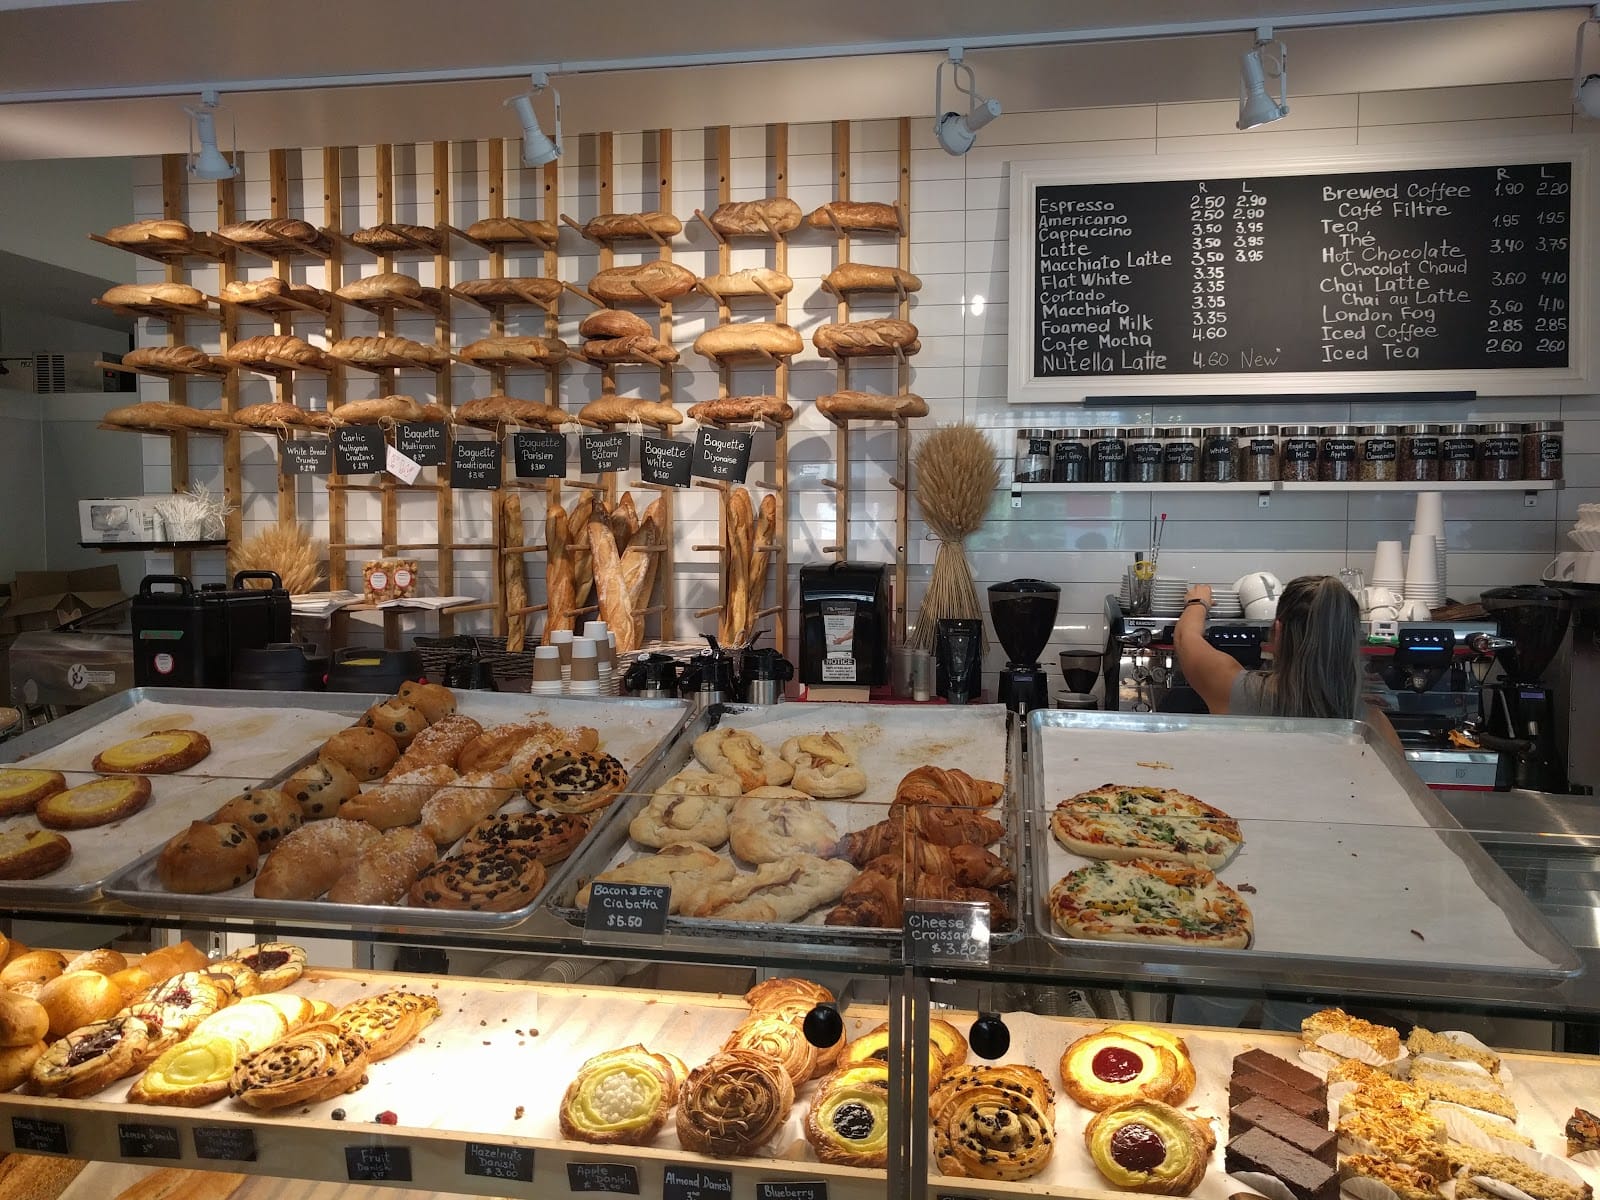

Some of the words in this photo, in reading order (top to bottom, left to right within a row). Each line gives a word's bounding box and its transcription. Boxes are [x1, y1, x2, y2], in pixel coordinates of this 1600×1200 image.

[1497, 167, 1511, 180] R
[1541, 166, 1555, 178] L
[1199, 182, 1208, 193] R
[1242, 181, 1252, 193] L
[1323, 184, 1398, 201] Brewed
[1407, 182, 1471, 202] Coffee
[1536, 182, 1569, 196] 2.20
[1039, 198, 1115, 214] Espresso
[1190, 195, 1225, 210] 2.50
[1236, 194, 1267, 207] 2.90
[1338, 201, 1383, 220] Café
[1393, 200, 1452, 218] Filtre
[1039, 214, 1127, 228] Americano
[1191, 209, 1225, 222] 2.50
[1233, 208, 1265, 219] 2.90
[1320, 219, 1359, 234] Tea
[1491, 214, 1520, 228] 1.95
[1537, 211, 1566, 225] 1.95
[1039, 227, 1132, 242] Cappuccino
[1191, 223, 1222, 236] 3.50
[1235, 222, 1264, 234] 3.95
[1339, 231, 1376, 247] Thé
[1040, 242, 1092, 257] Latte
[1191, 237, 1222, 250] 3.50
[1233, 236, 1265, 248] 3.95
[1322, 246, 1354, 263] Hot
[1362, 239, 1466, 262] Chocolate
[1489, 239, 1525, 253] 3.40
[1535, 236, 1569, 251] 3.75
[1040, 255, 1121, 273] Macchiato
[1127, 251, 1173, 268] Latte
[1191, 252, 1225, 266] 3.50
[1235, 249, 1264, 262] 3.95
[1340, 260, 1411, 277] Chocolat
[1418, 259, 1468, 275] Chaud
[1041, 274, 1077, 290] Flat
[1081, 271, 1132, 286] White
[1193, 267, 1225, 280] 3.35
[1319, 276, 1363, 293] Chai
[1375, 276, 1431, 292] Latte
[1491, 271, 1527, 287] 3.60
[1040, 289, 1105, 304] Cortado
[1192, 280, 1225, 294] 3.35
[1043, 300, 1130, 319] Macchiato
[1191, 295, 1226, 309] 3.35
[1341, 292, 1379, 306] Chai
[1389, 293, 1409, 305] au
[1415, 289, 1472, 304] Latte
[1488, 299, 1524, 316] 3.60
[1323, 304, 1393, 324] London
[1401, 306, 1436, 323] Fog
[1042, 319, 1111, 337] Foamed
[1119, 314, 1154, 331] Milk
[1193, 311, 1228, 326] 3.35
[1321, 325, 1366, 341] Iced
[1375, 323, 1440, 343] Coffee
[1488, 318, 1524, 333] 2.85
[1535, 318, 1568, 332] 2.85
[1041, 336, 1089, 357] Cafe
[1099, 333, 1152, 349] Mocha
[1192, 328, 1228, 342] 4.60
[1322, 344, 1368, 363] Iced
[1382, 343, 1420, 361] Tea
[1485, 338, 1523, 353] 2.60
[1043, 351, 1114, 373] Nutella
[1122, 349, 1168, 370] Latte
[1193, 351, 1229, 367] 4.60
[341, 431, 366, 443] Garlic
[404, 426, 440, 443] Baguette
[519, 434, 560, 452] Baguette
[704, 433, 745, 452] Baguette
[287, 447, 307, 456] White
[309, 444, 327, 456] Bread
[401, 441, 436, 456] Multigrain
[585, 436, 623, 452] Baguette
[645, 440, 687, 459] Baguette
[458, 446, 495, 461] Baguette
[522, 450, 553, 461] Parisien
[704, 450, 738, 465] Dijonaise
[1330, 450, 1346, 459] Apple
[455, 460, 496, 471] Traditional
[646, 457, 673, 469] White
[826, 658, 854, 666] NOTICE
[594, 884, 628, 896] Bacon
[640, 886, 664, 898] Brie
[603, 897, 659, 910] Ciabatta
[908, 914, 966, 929] Cheese
[912, 928, 973, 941] Croissan
[361, 1150, 390, 1164] Fruit
[472, 1144, 523, 1161] Hazelnuts
[480, 1157, 516, 1169] Danish
[577, 1165, 608, 1178] Apple
[665, 1172, 700, 1188] Almond
[703, 1175, 731, 1192] Danish
[764, 1184, 814, 1199] Blueberry
